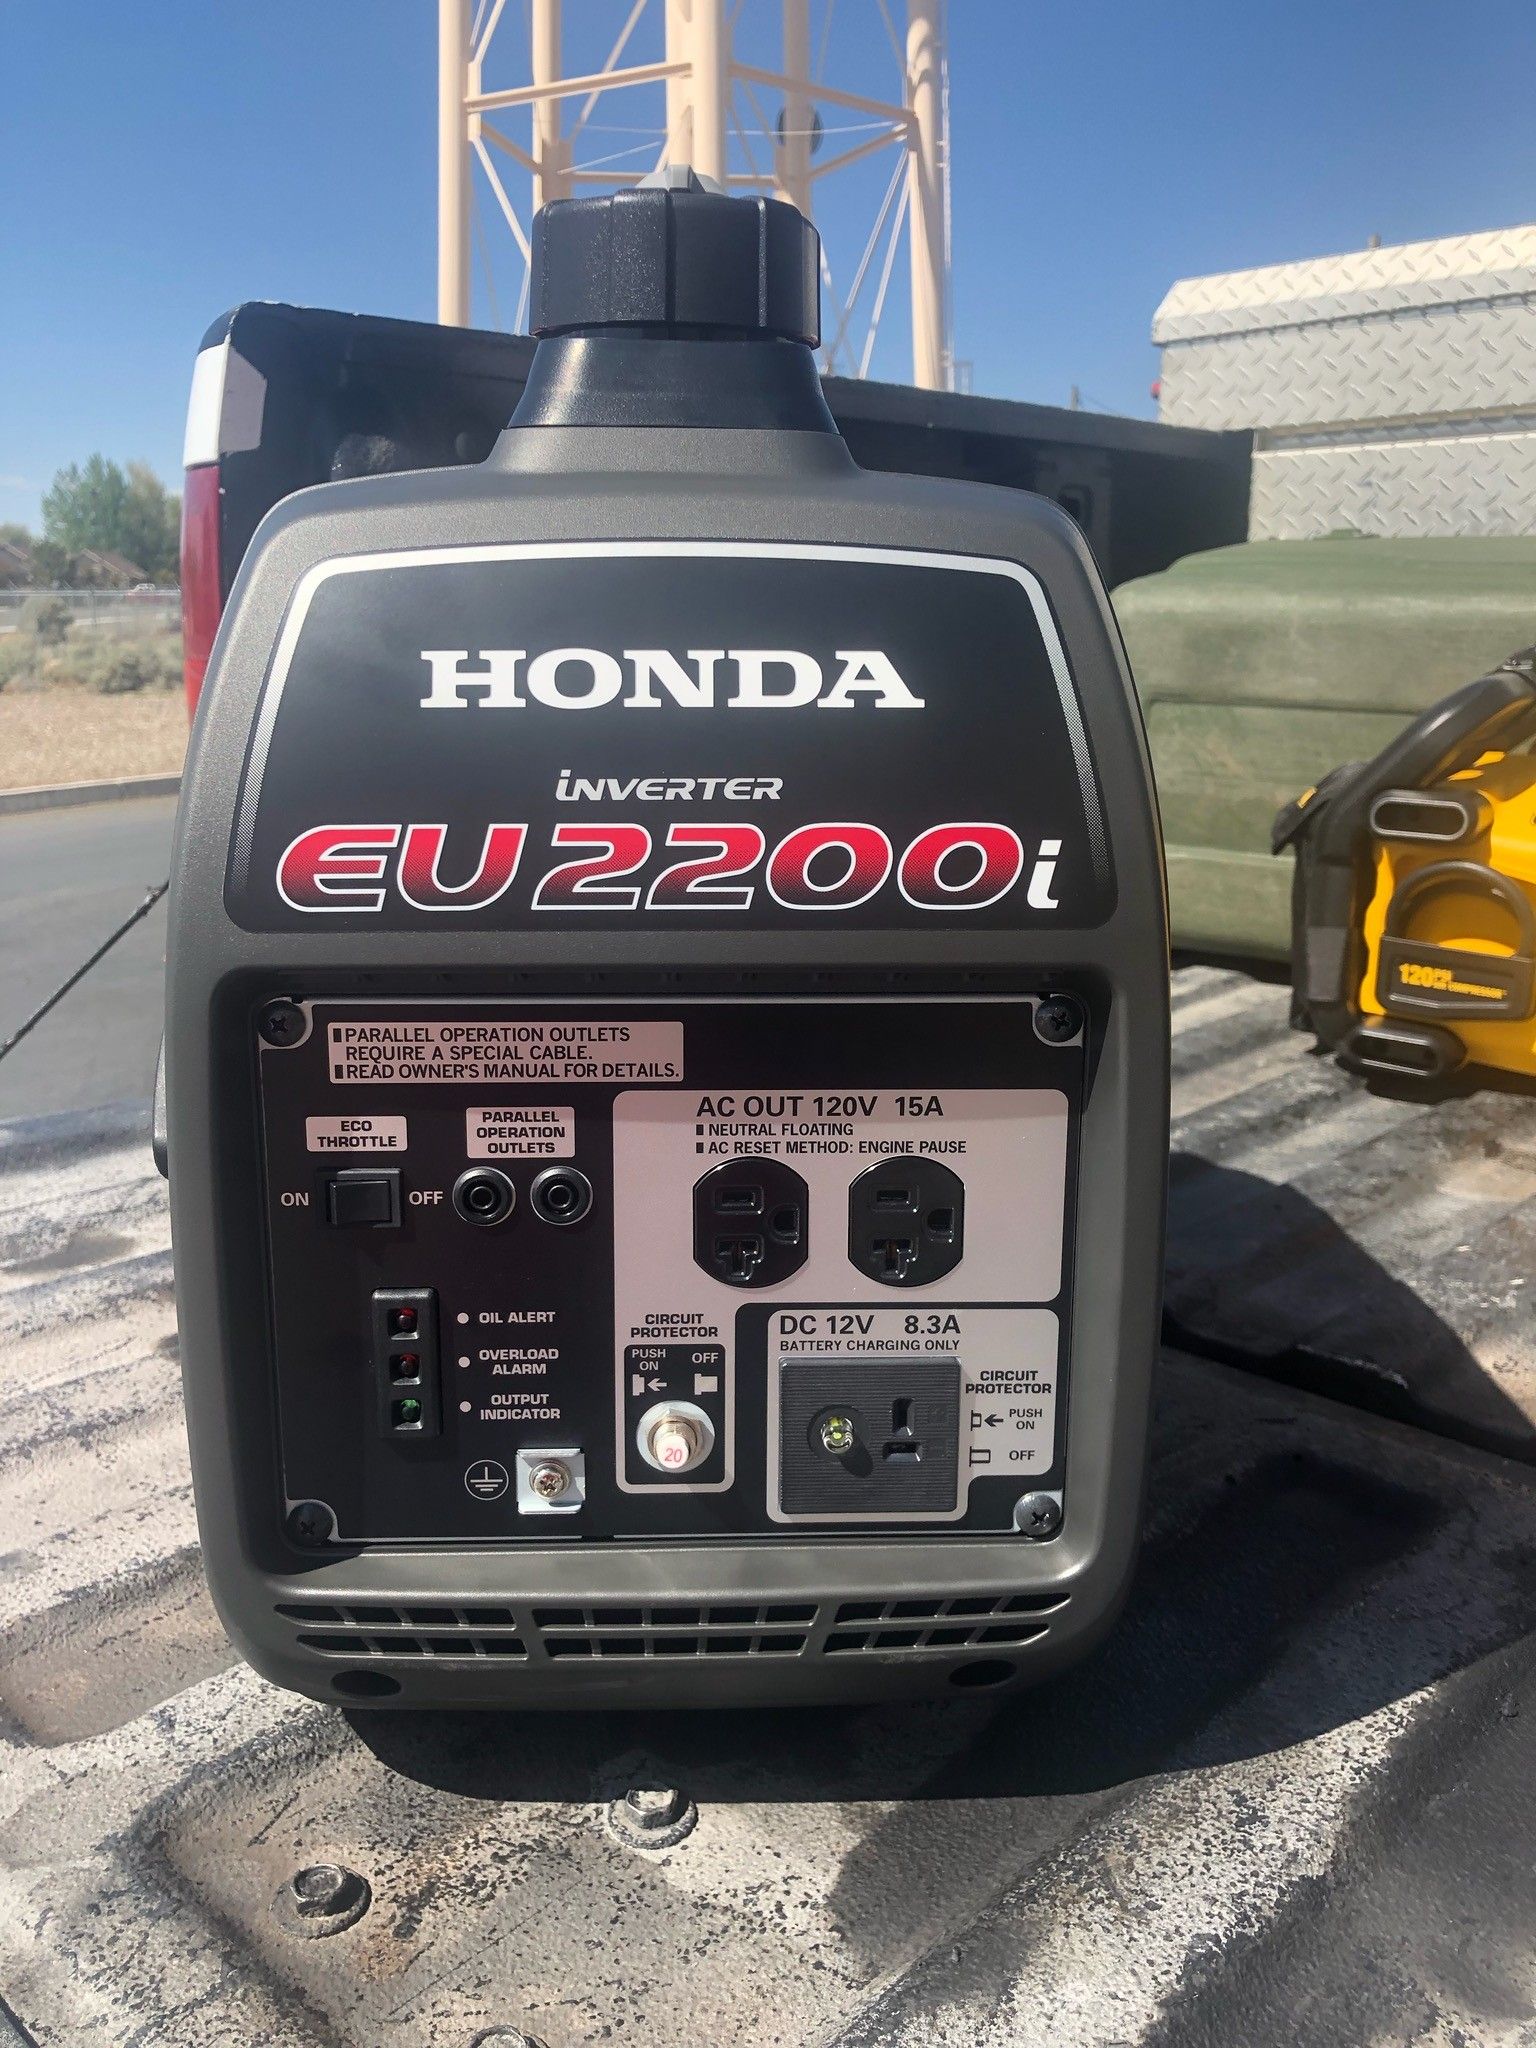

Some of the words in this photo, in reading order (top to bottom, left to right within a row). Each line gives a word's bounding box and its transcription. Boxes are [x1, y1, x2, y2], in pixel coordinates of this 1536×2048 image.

[420, 648, 924, 709] HONDA
[345, 1027, 435, 1043] PARALLEL
[439, 1026, 544, 1043] OPERATION
[549, 1026, 631, 1042] OUTLETS
[345, 1045, 426, 1065] REQUIRE
[431, 1045, 444, 1061] A
[449, 1045, 524, 1061] SPECIAL
[529, 1045, 593, 1061] CABLE.
[346, 1064, 395, 1079] READ
[398, 1063, 480, 1079] OWNER'S
[483, 1063, 561, 1079] MANUAL
[564, 1062, 598, 1078] FOR
[602, 1062, 680, 1078] DETAILS.
[696, 1096, 735, 1118] AC
[743, 1095, 804, 1118] OUT
[812, 1095, 879, 1117] 120V
[894, 1095, 944, 1117] 15A
[482, 1110, 560, 1123] PARALLEL
[340, 1120, 373, 1132] ECO
[476, 1126, 566, 1139] OPERATION
[708, 1123, 777, 1137] NEUTRAL
[781, 1122, 854, 1136] FLOATING
[316, 1135, 398, 1148] THROTTLE
[487, 1141, 556, 1154] OUTLETS
[708, 1141, 729, 1155] AC
[733, 1140, 782, 1154] RESET
[785, 1140, 854, 1154] METHOD:
[858, 1140, 915, 1154] ENGINE
[919, 1140, 967, 1154] PAUSE
[280, 1192, 309, 1207] ON
[408, 1190, 444, 1206] OFF
[478, 1312, 504, 1324] OIL
[507, 1311, 556, 1324] ALERT
[644, 1313, 705, 1325] CIRCUIT
[779, 1314, 817, 1335] DC
[826, 1314, 875, 1335] 12V
[904, 1314, 961, 1335] 8.3A
[630, 1326, 719, 1339] PROTECTOR
[780, 1340, 842, 1352] BATTERY
[846, 1339, 921, 1351] CHARGING
[924, 1339, 960, 1351] ONLY
[478, 1348, 559, 1361] OVERLOAD
[631, 1348, 666, 1359] PUSH
[691, 1352, 719, 1364] OFF
[492, 1363, 547, 1375] ALARM
[639, 1360, 659, 1371] ON
[979, 1370, 1039, 1382] CIRCUIT
[965, 1383, 1052, 1394] PROTECTOR
[490, 1393, 550, 1406] OUTPUT
[480, 1408, 561, 1421] INDICATOR
[1009, 1408, 1043, 1418] PUSH
[1015, 1420, 1035, 1430] ON
[664, 1447, 683, 1463] 20
[1008, 1449, 1036, 1461] OFF
